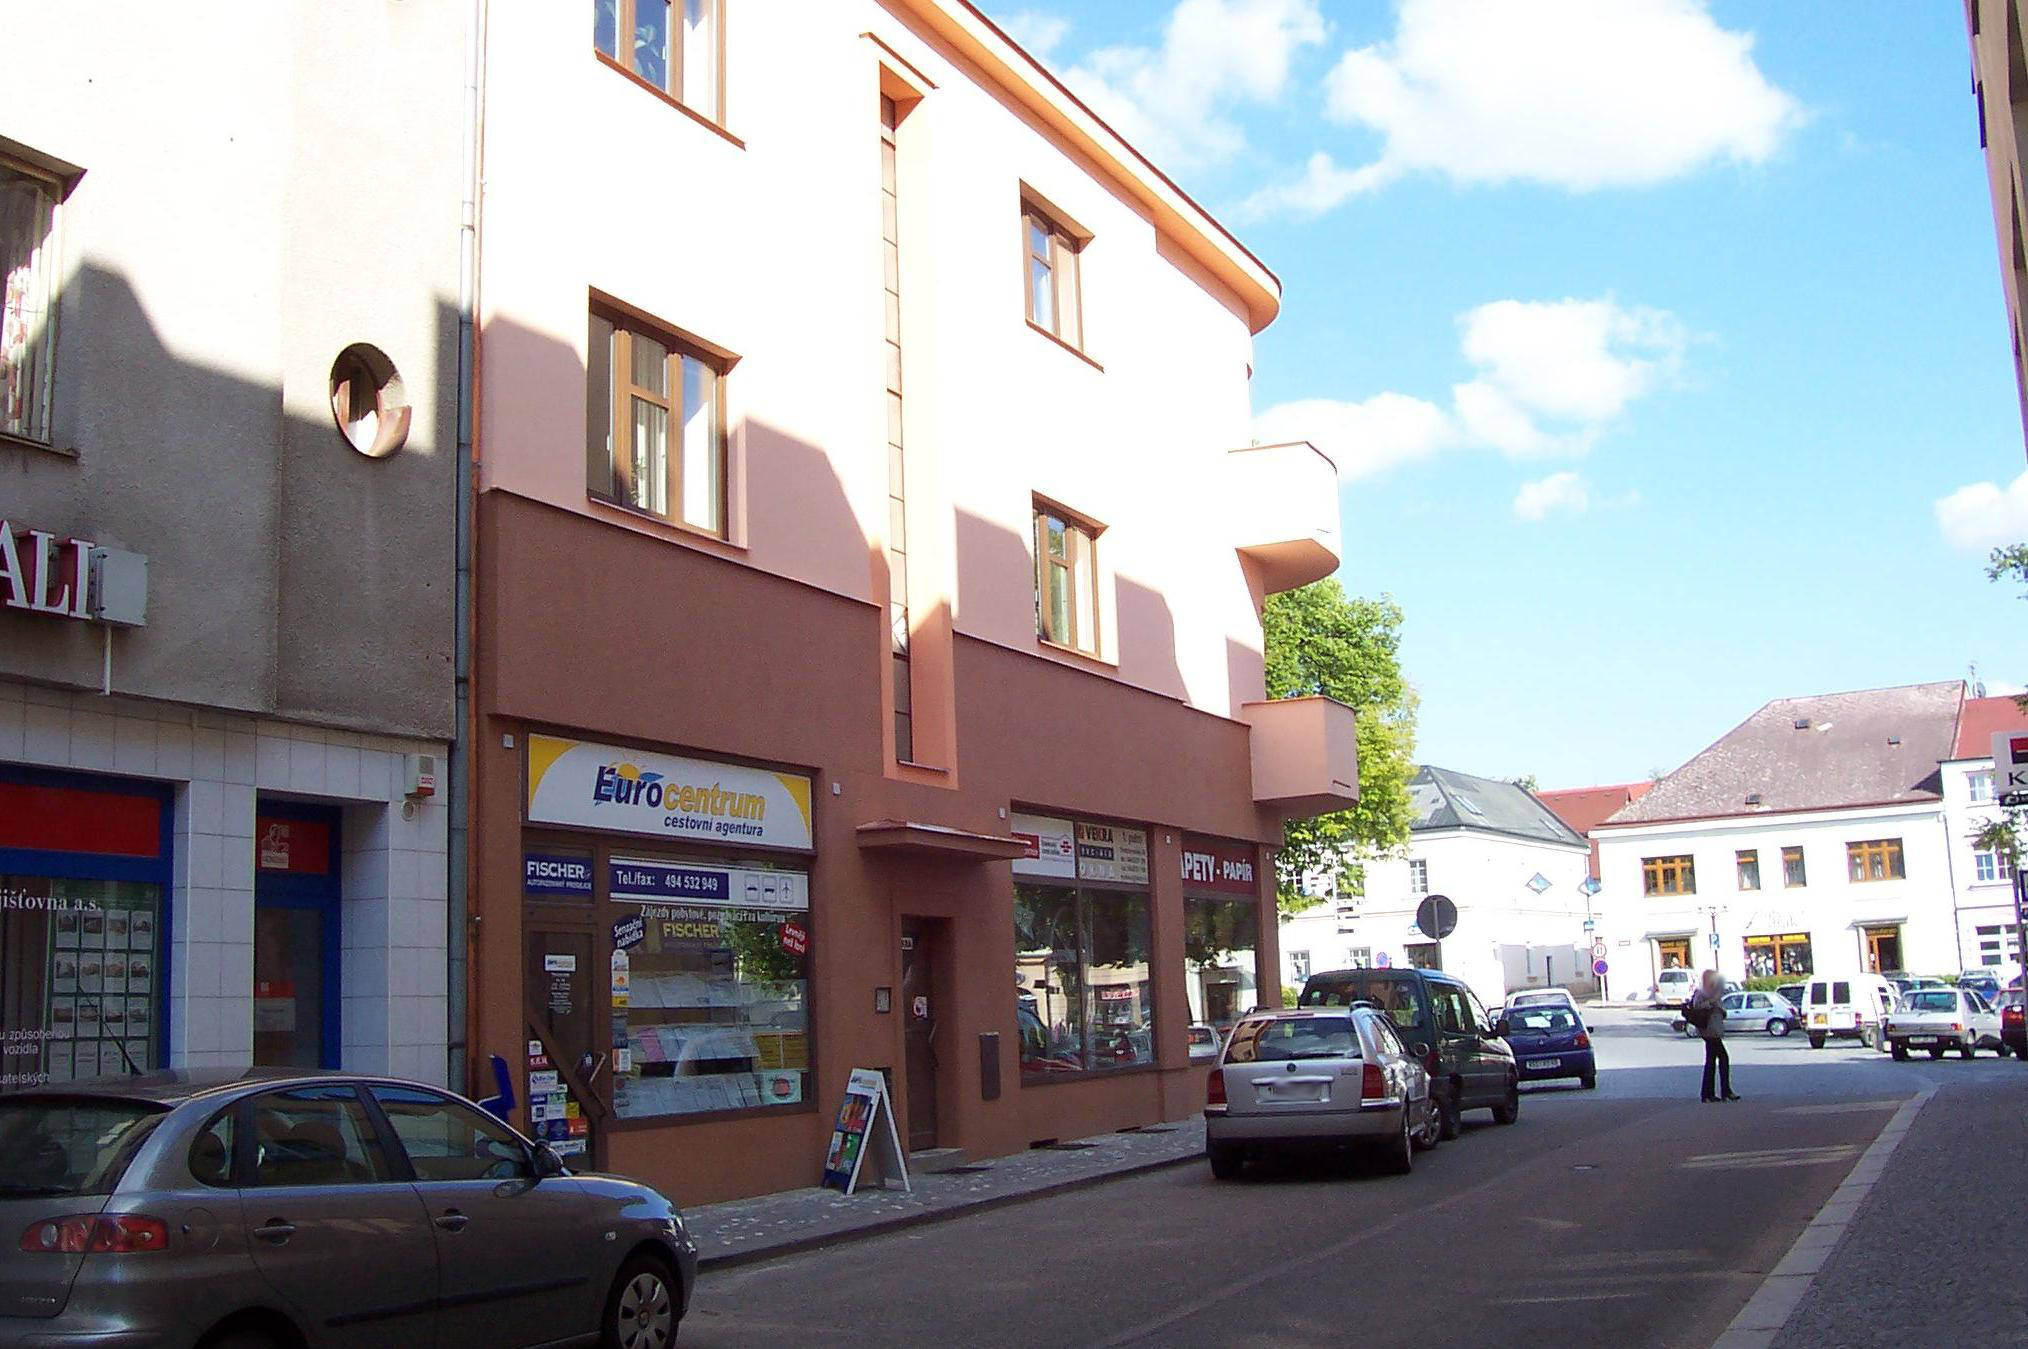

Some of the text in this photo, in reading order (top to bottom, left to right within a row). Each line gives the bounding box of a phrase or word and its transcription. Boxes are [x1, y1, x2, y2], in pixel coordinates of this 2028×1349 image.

[592, 764, 767, 821] Eurocentrum
[664, 814, 764, 837] cestovní agentura
[527, 860, 586, 880] FISCHER
[1223, 858, 1253, 883] PAPÍR
[664, 874, 682, 888] 494
[683, 875, 701, 890] 532
[701, 876, 719, 891] 949
[74, 896, 102, 912] a.s.
[662, 922, 721, 939] FISCHER
[3, 1042, 39, 1055] vozidla
